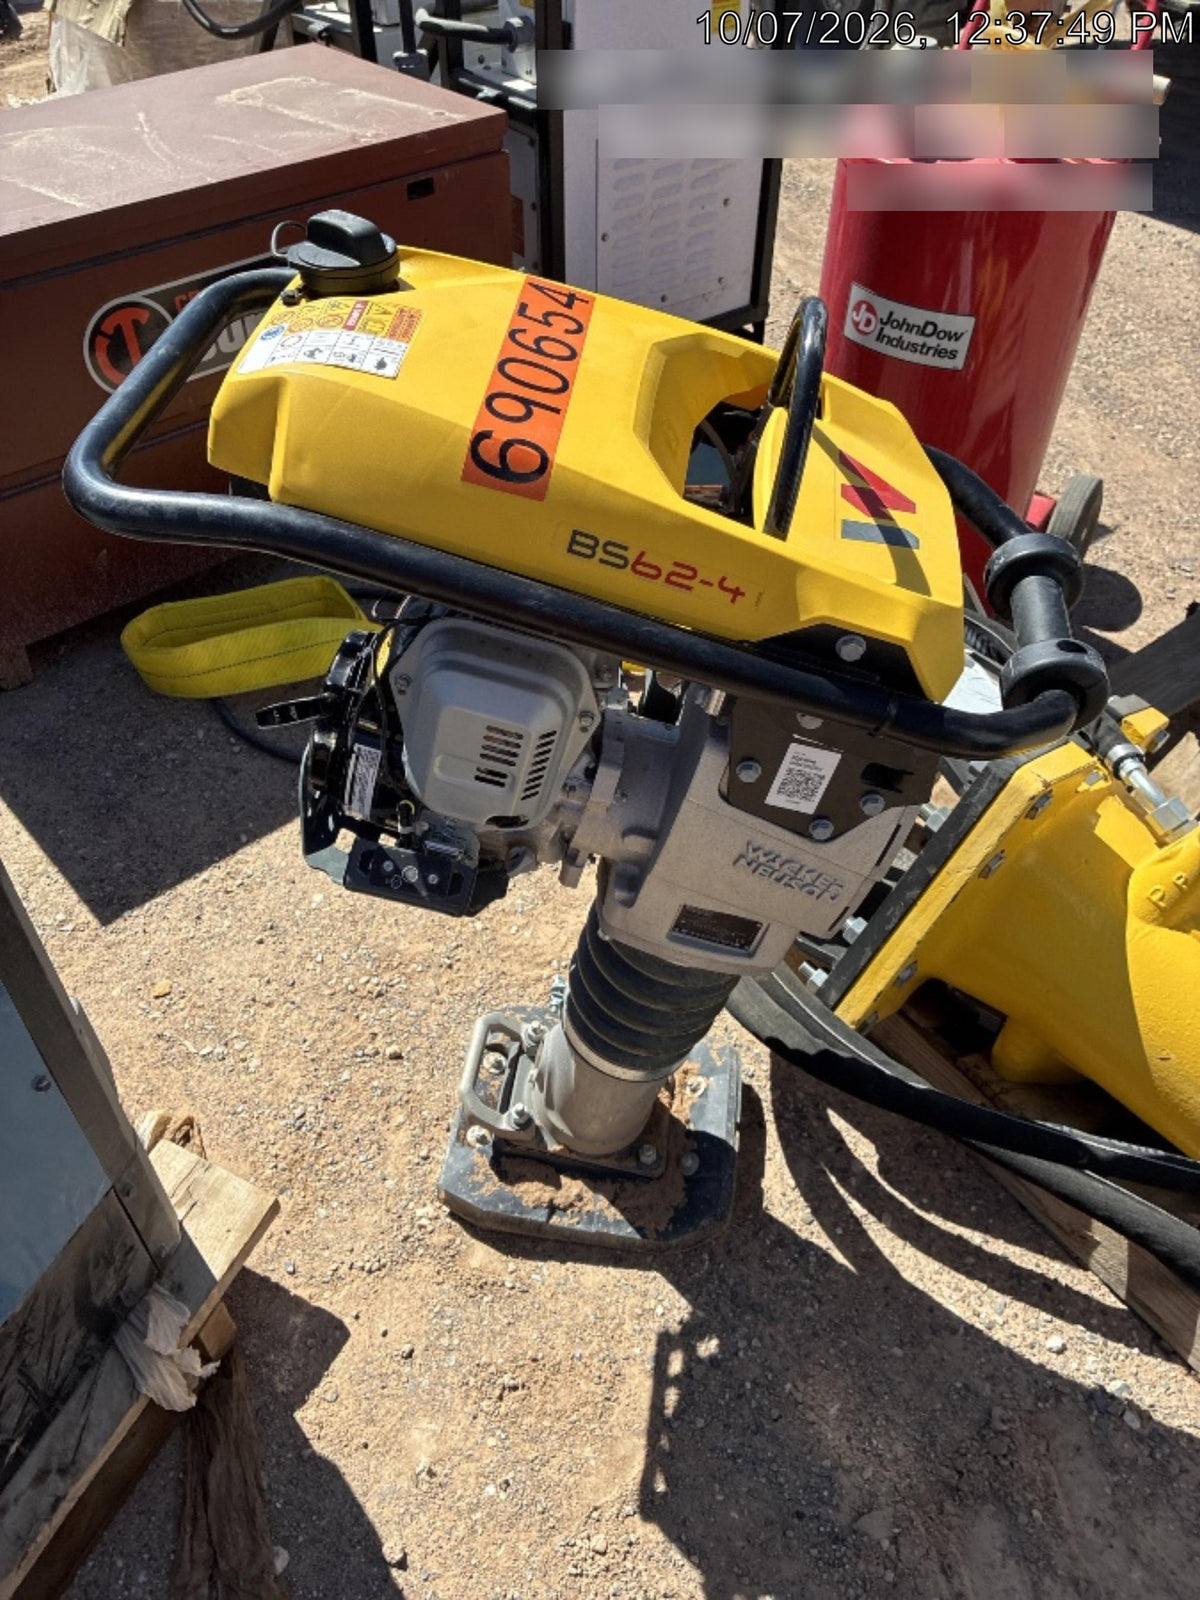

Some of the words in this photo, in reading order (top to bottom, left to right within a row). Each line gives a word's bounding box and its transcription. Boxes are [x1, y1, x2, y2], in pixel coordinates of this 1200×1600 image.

[875, 326, 959, 360] Industries
[879, 310, 965, 342] JohnDow
[470, 281, 590, 485] 690654
[566, 529, 746, 605] BS62-4
